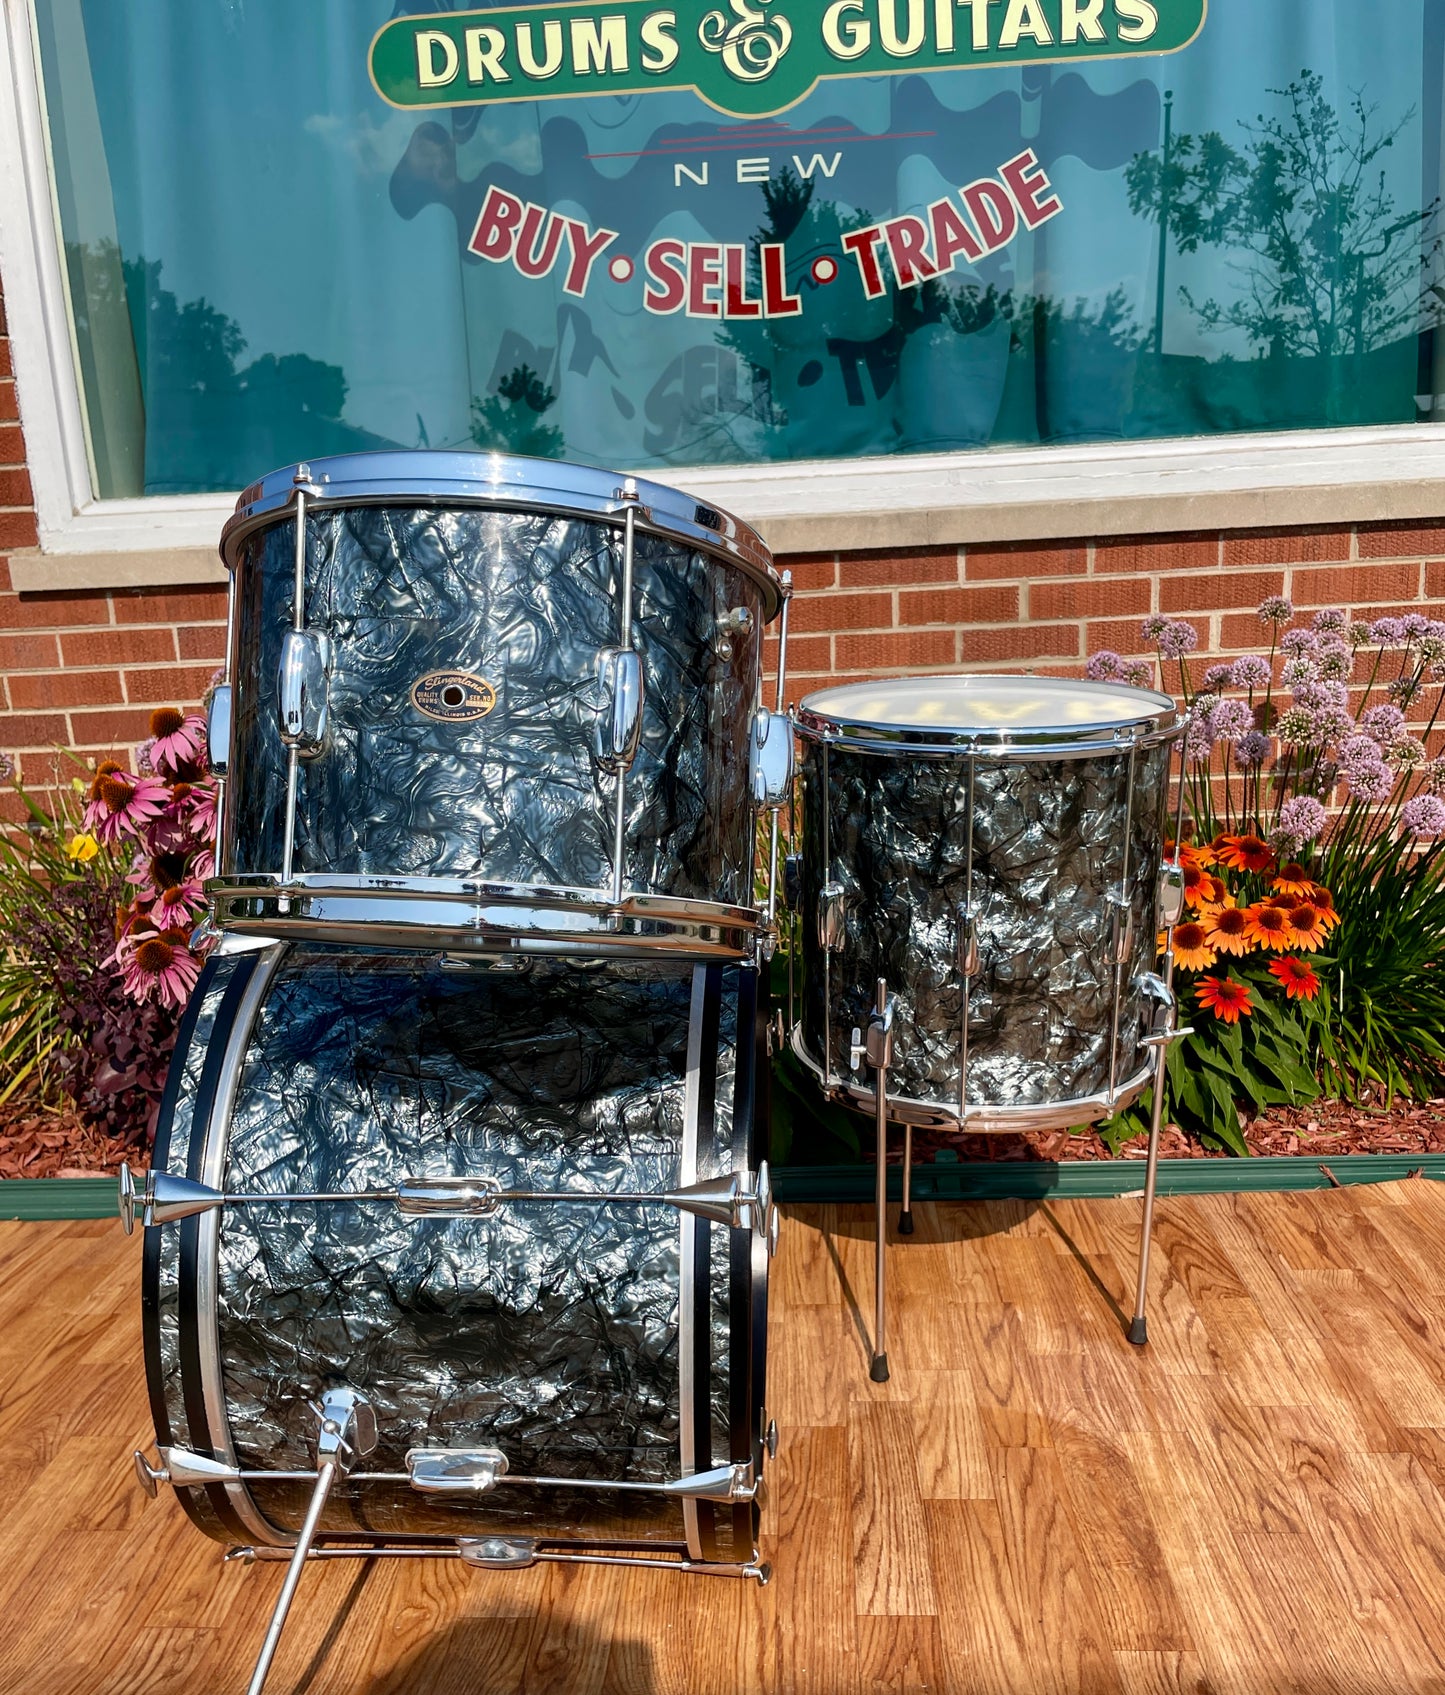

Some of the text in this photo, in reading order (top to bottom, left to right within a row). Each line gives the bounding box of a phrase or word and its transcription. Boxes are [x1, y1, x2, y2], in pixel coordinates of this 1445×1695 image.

[414, 0, 1160, 88] DRUMS & GUITARS
[674, 152, 843, 187] NEW
[467, 147, 1064, 320] BUY SELL TRADE
[424, 676, 486, 694] Slingerland
